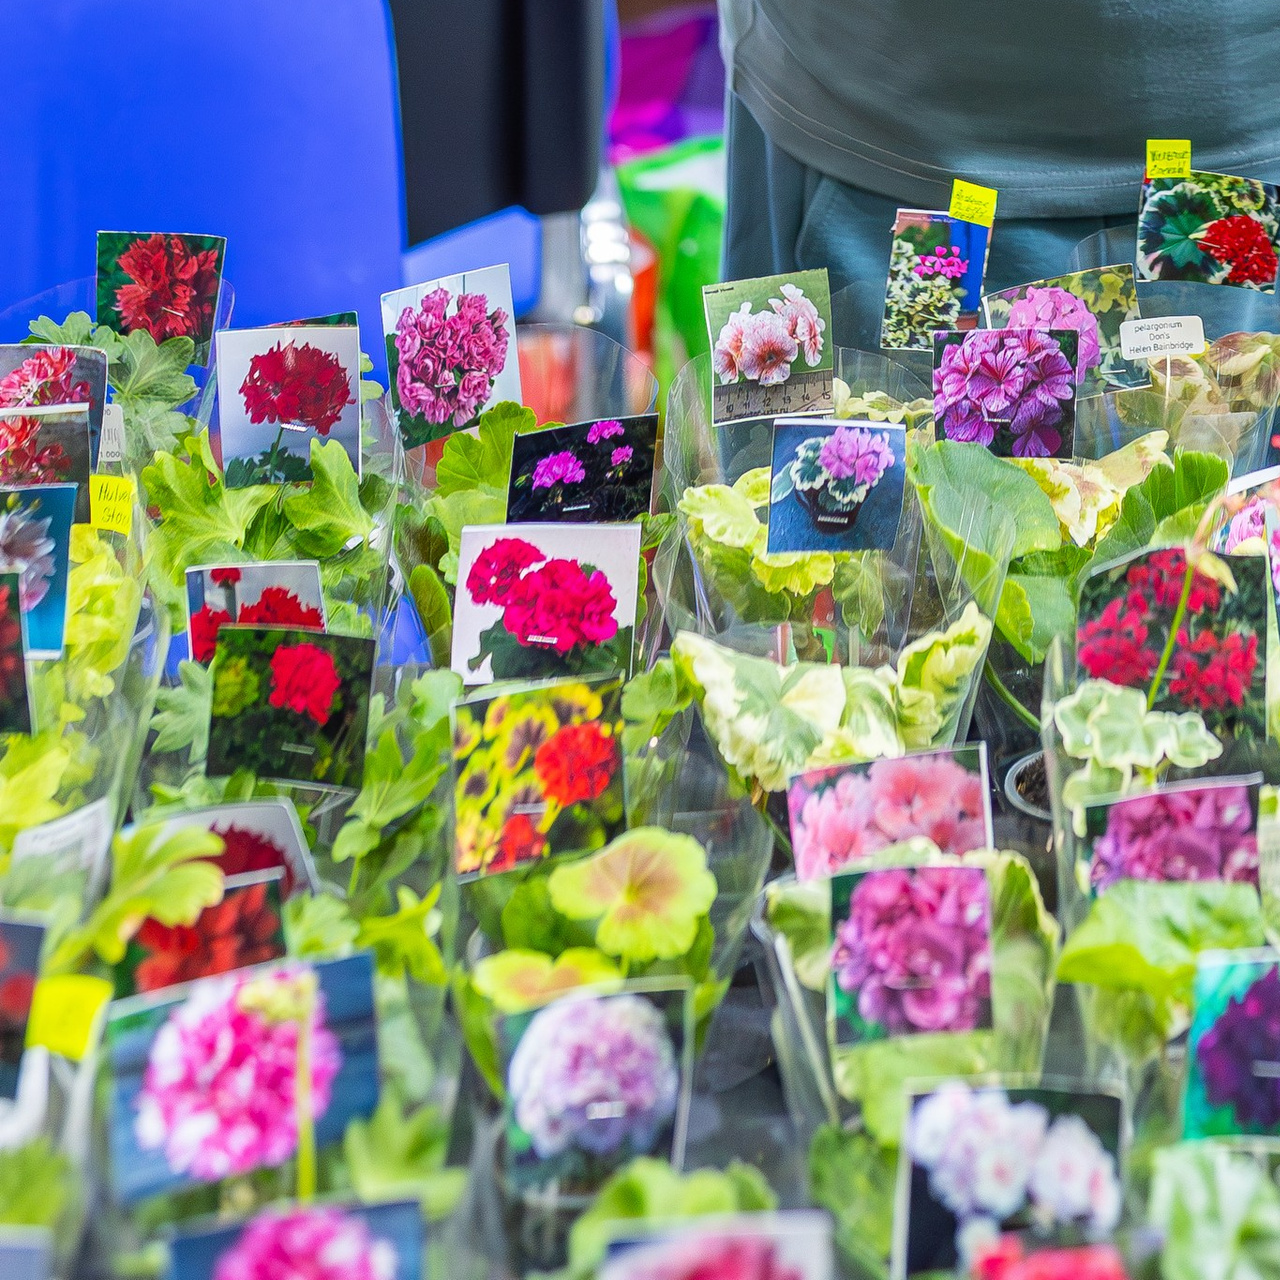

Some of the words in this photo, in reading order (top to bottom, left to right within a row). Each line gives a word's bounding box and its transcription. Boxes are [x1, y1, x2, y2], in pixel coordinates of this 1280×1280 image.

[1134, 321, 1183, 334] pelargonium
[1149, 332, 1171, 341] Don's
[1129, 346, 1152, 354] Helen
[1153, 342, 1194, 352] Bainbridge
